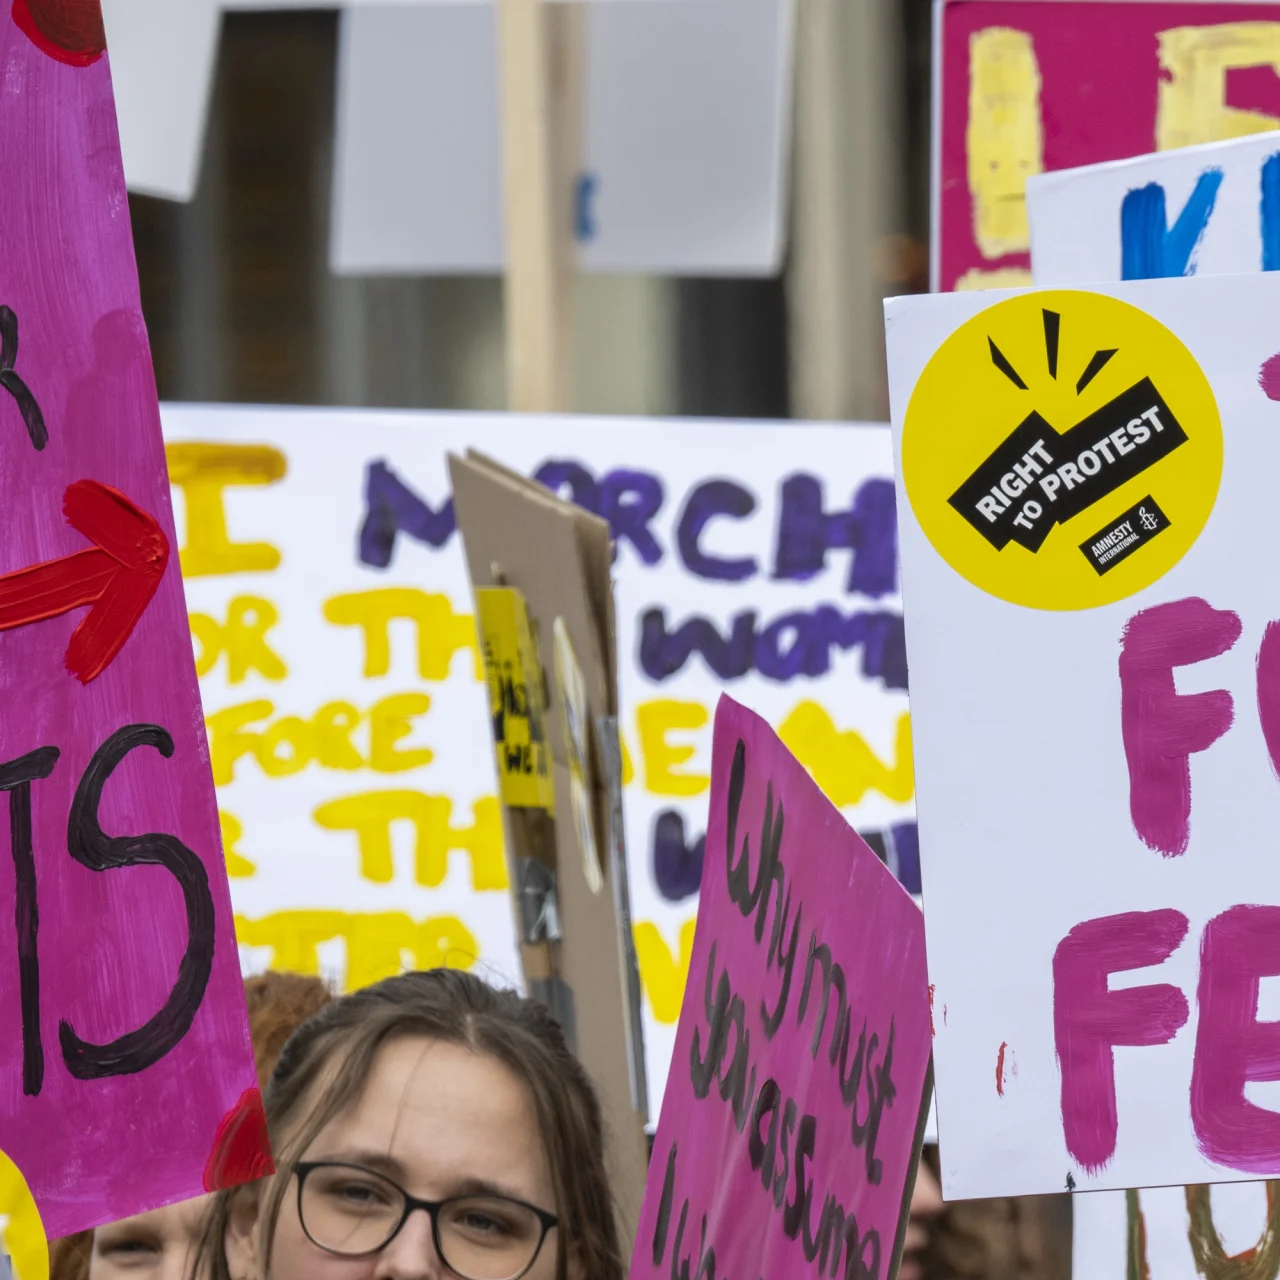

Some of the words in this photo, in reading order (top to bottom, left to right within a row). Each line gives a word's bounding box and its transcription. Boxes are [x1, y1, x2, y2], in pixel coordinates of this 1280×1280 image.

[163, 442, 288, 580] I
[974, 438, 1054, 524] RIGHT
[1012, 499, 1043, 531] TO
[1038, 404, 1165, 503] PROTEST
[1090, 520, 1134, 558] AMNESTY
[1097, 532, 1140, 565] INTERNATIONAL
[726, 736, 802, 1043] Why
[797, 926, 898, 1187] must
[690, 937, 758, 1135] you
[653, 1138, 677, 1267] I
